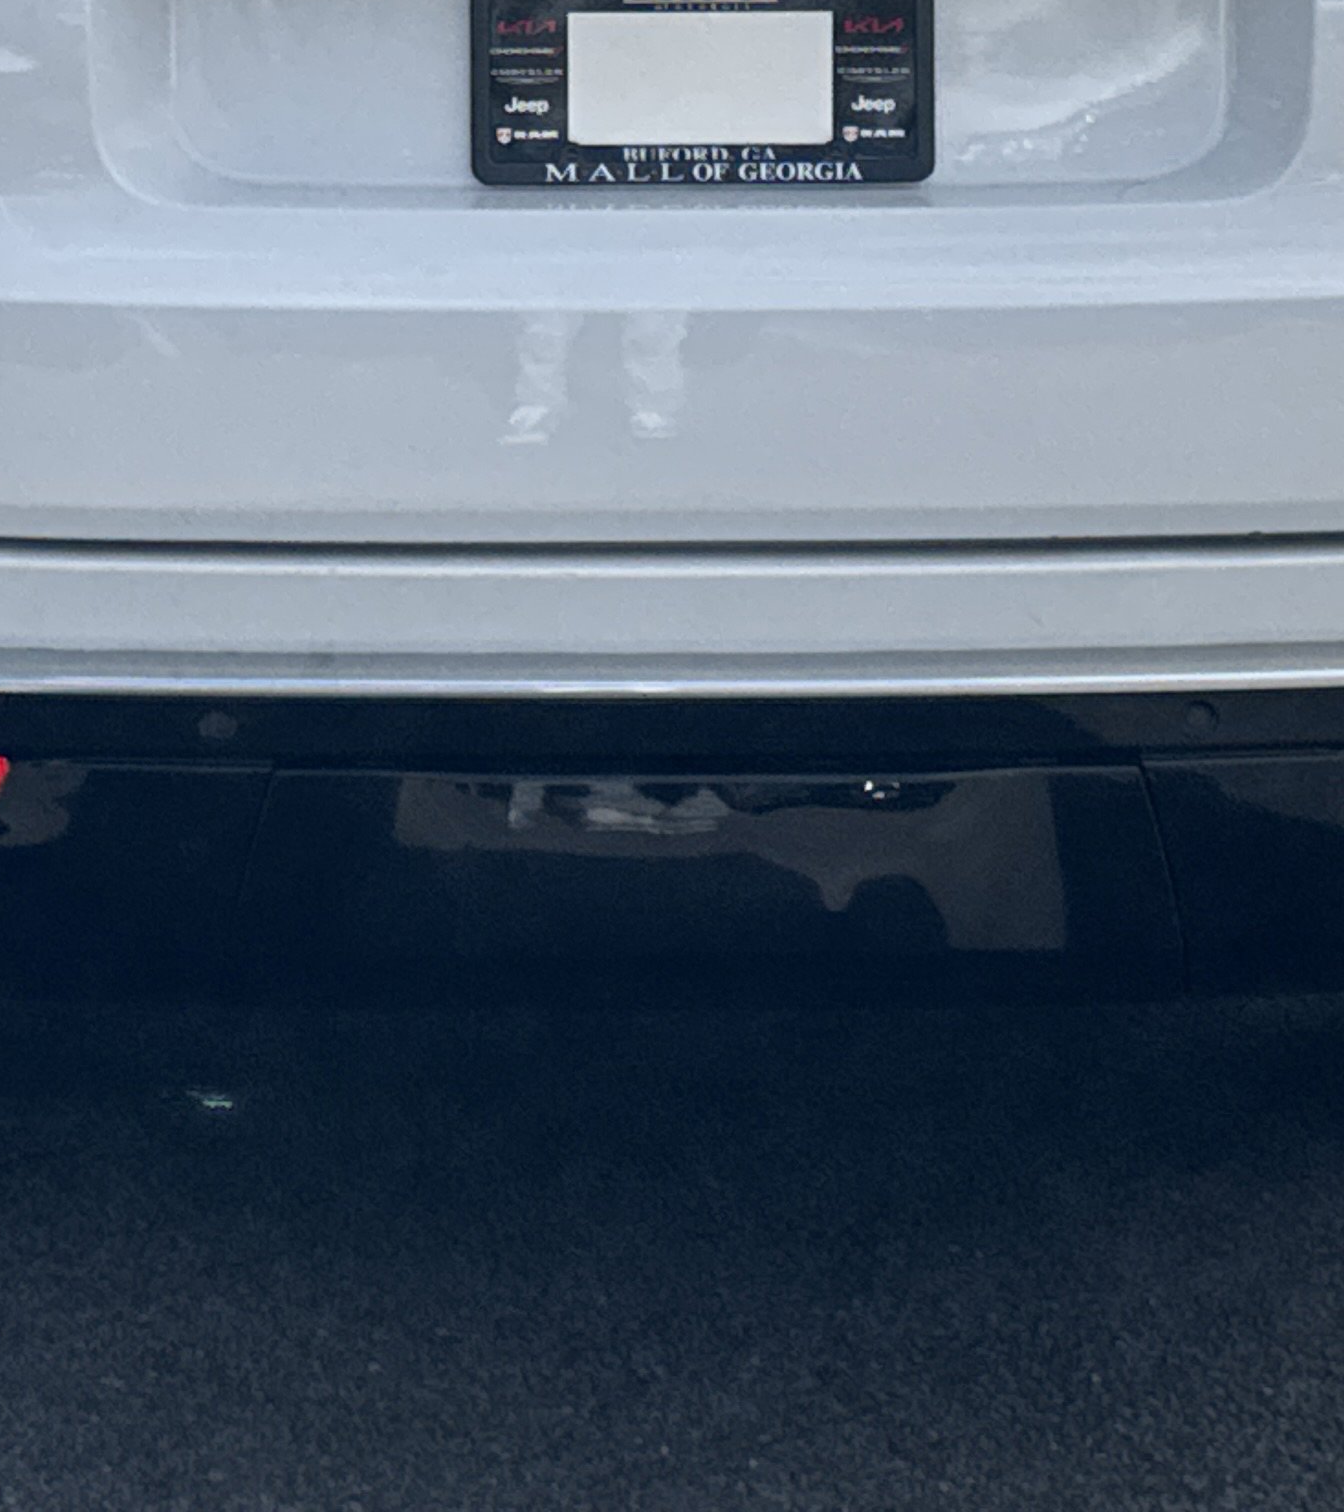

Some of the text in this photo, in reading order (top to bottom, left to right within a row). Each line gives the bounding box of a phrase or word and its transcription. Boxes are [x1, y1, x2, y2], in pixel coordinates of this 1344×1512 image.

[504, 95, 549, 116] Jeep
[851, 93, 896, 114] Jeep
[692, 162, 731, 182] OF
[737, 161, 864, 182] GEORGIA
